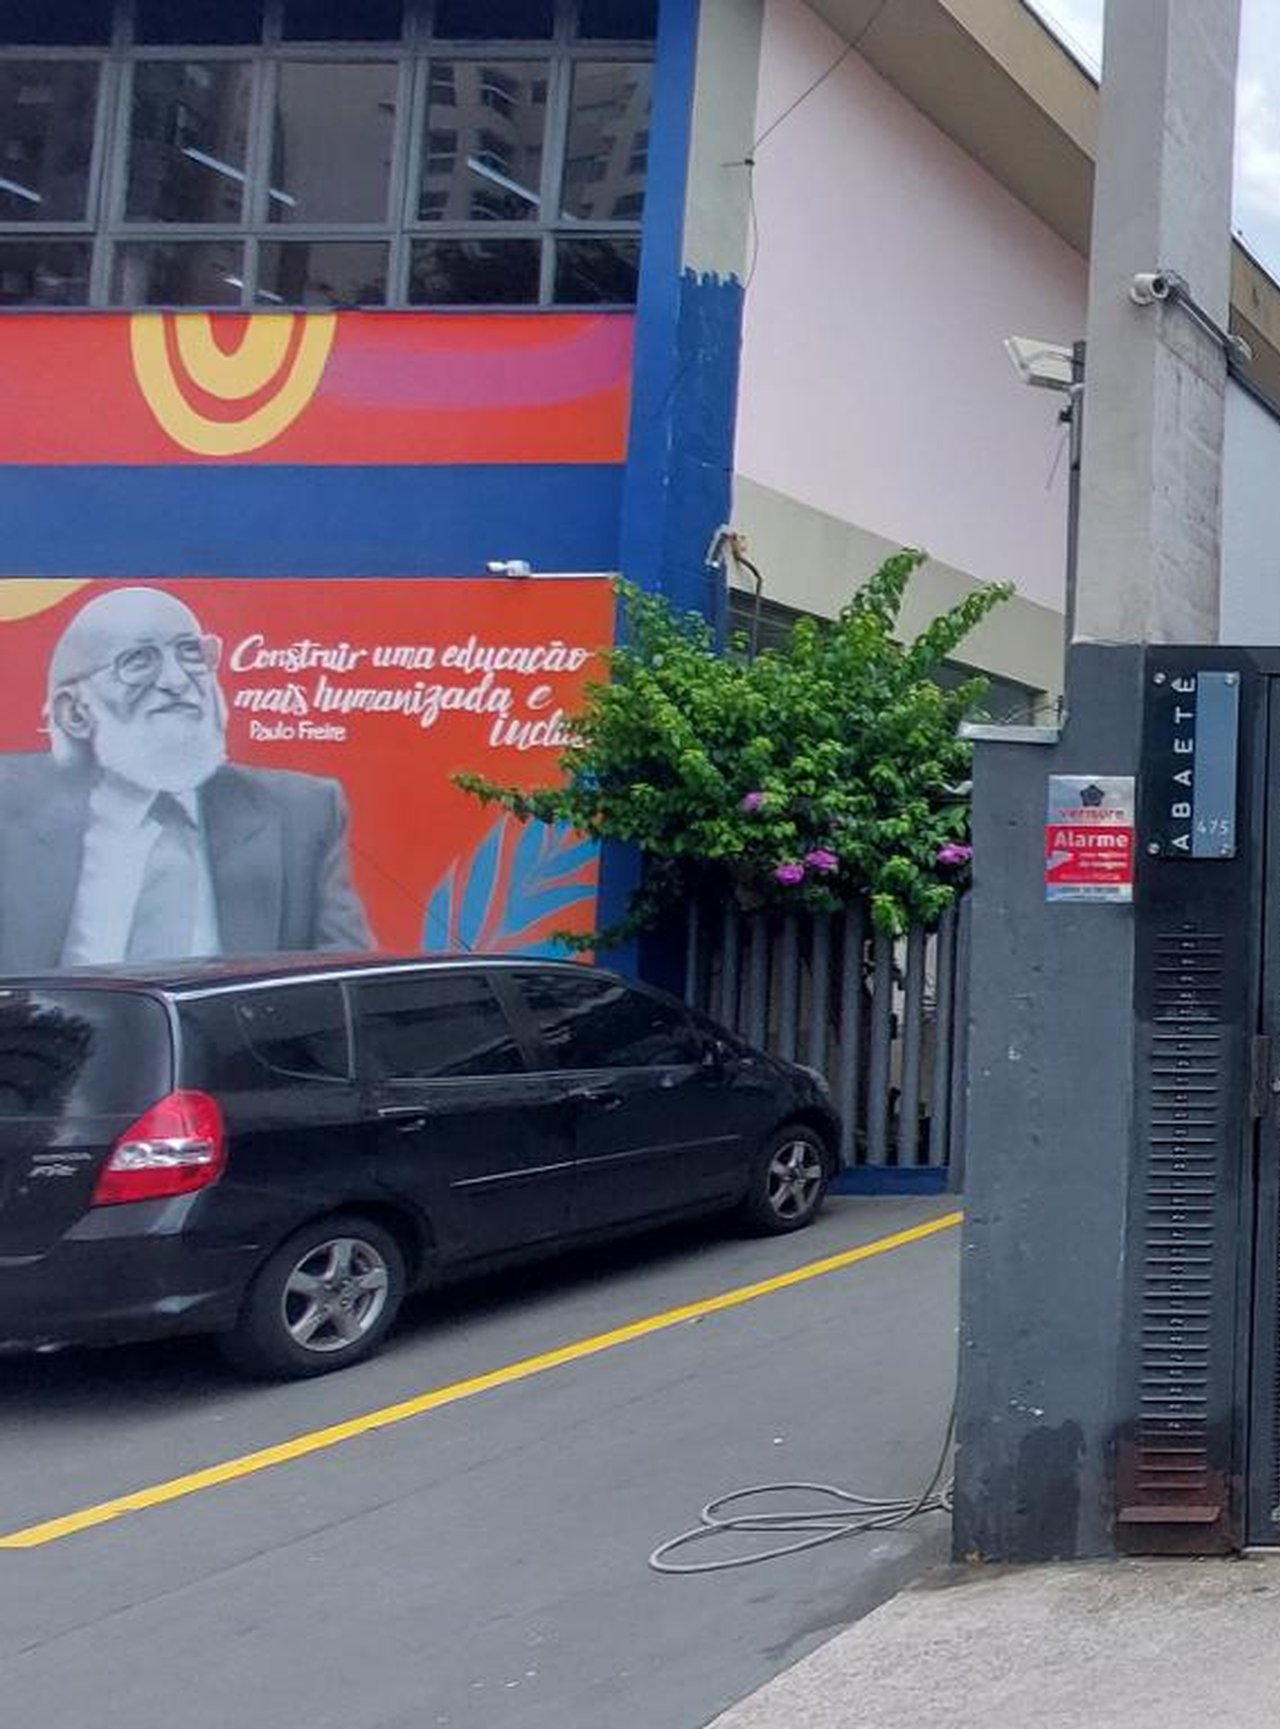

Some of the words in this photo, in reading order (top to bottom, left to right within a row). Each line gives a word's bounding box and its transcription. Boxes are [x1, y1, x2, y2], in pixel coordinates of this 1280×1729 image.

[230, 633, 369, 673] Construir
[373, 644, 434, 671] uma
[441, 635, 596, 673] educação
[234, 682, 308, 716] mais
[313, 673, 513, 728] humanizada
[527, 685, 553, 710] e
[249, 720, 295, 741] Paulo
[298, 720, 347, 742] Freire
[1171, 677, 1196, 850] ABAETÊ
[1053, 829, 1129, 848] Alarme
[1197, 819, 1229, 834] 475
